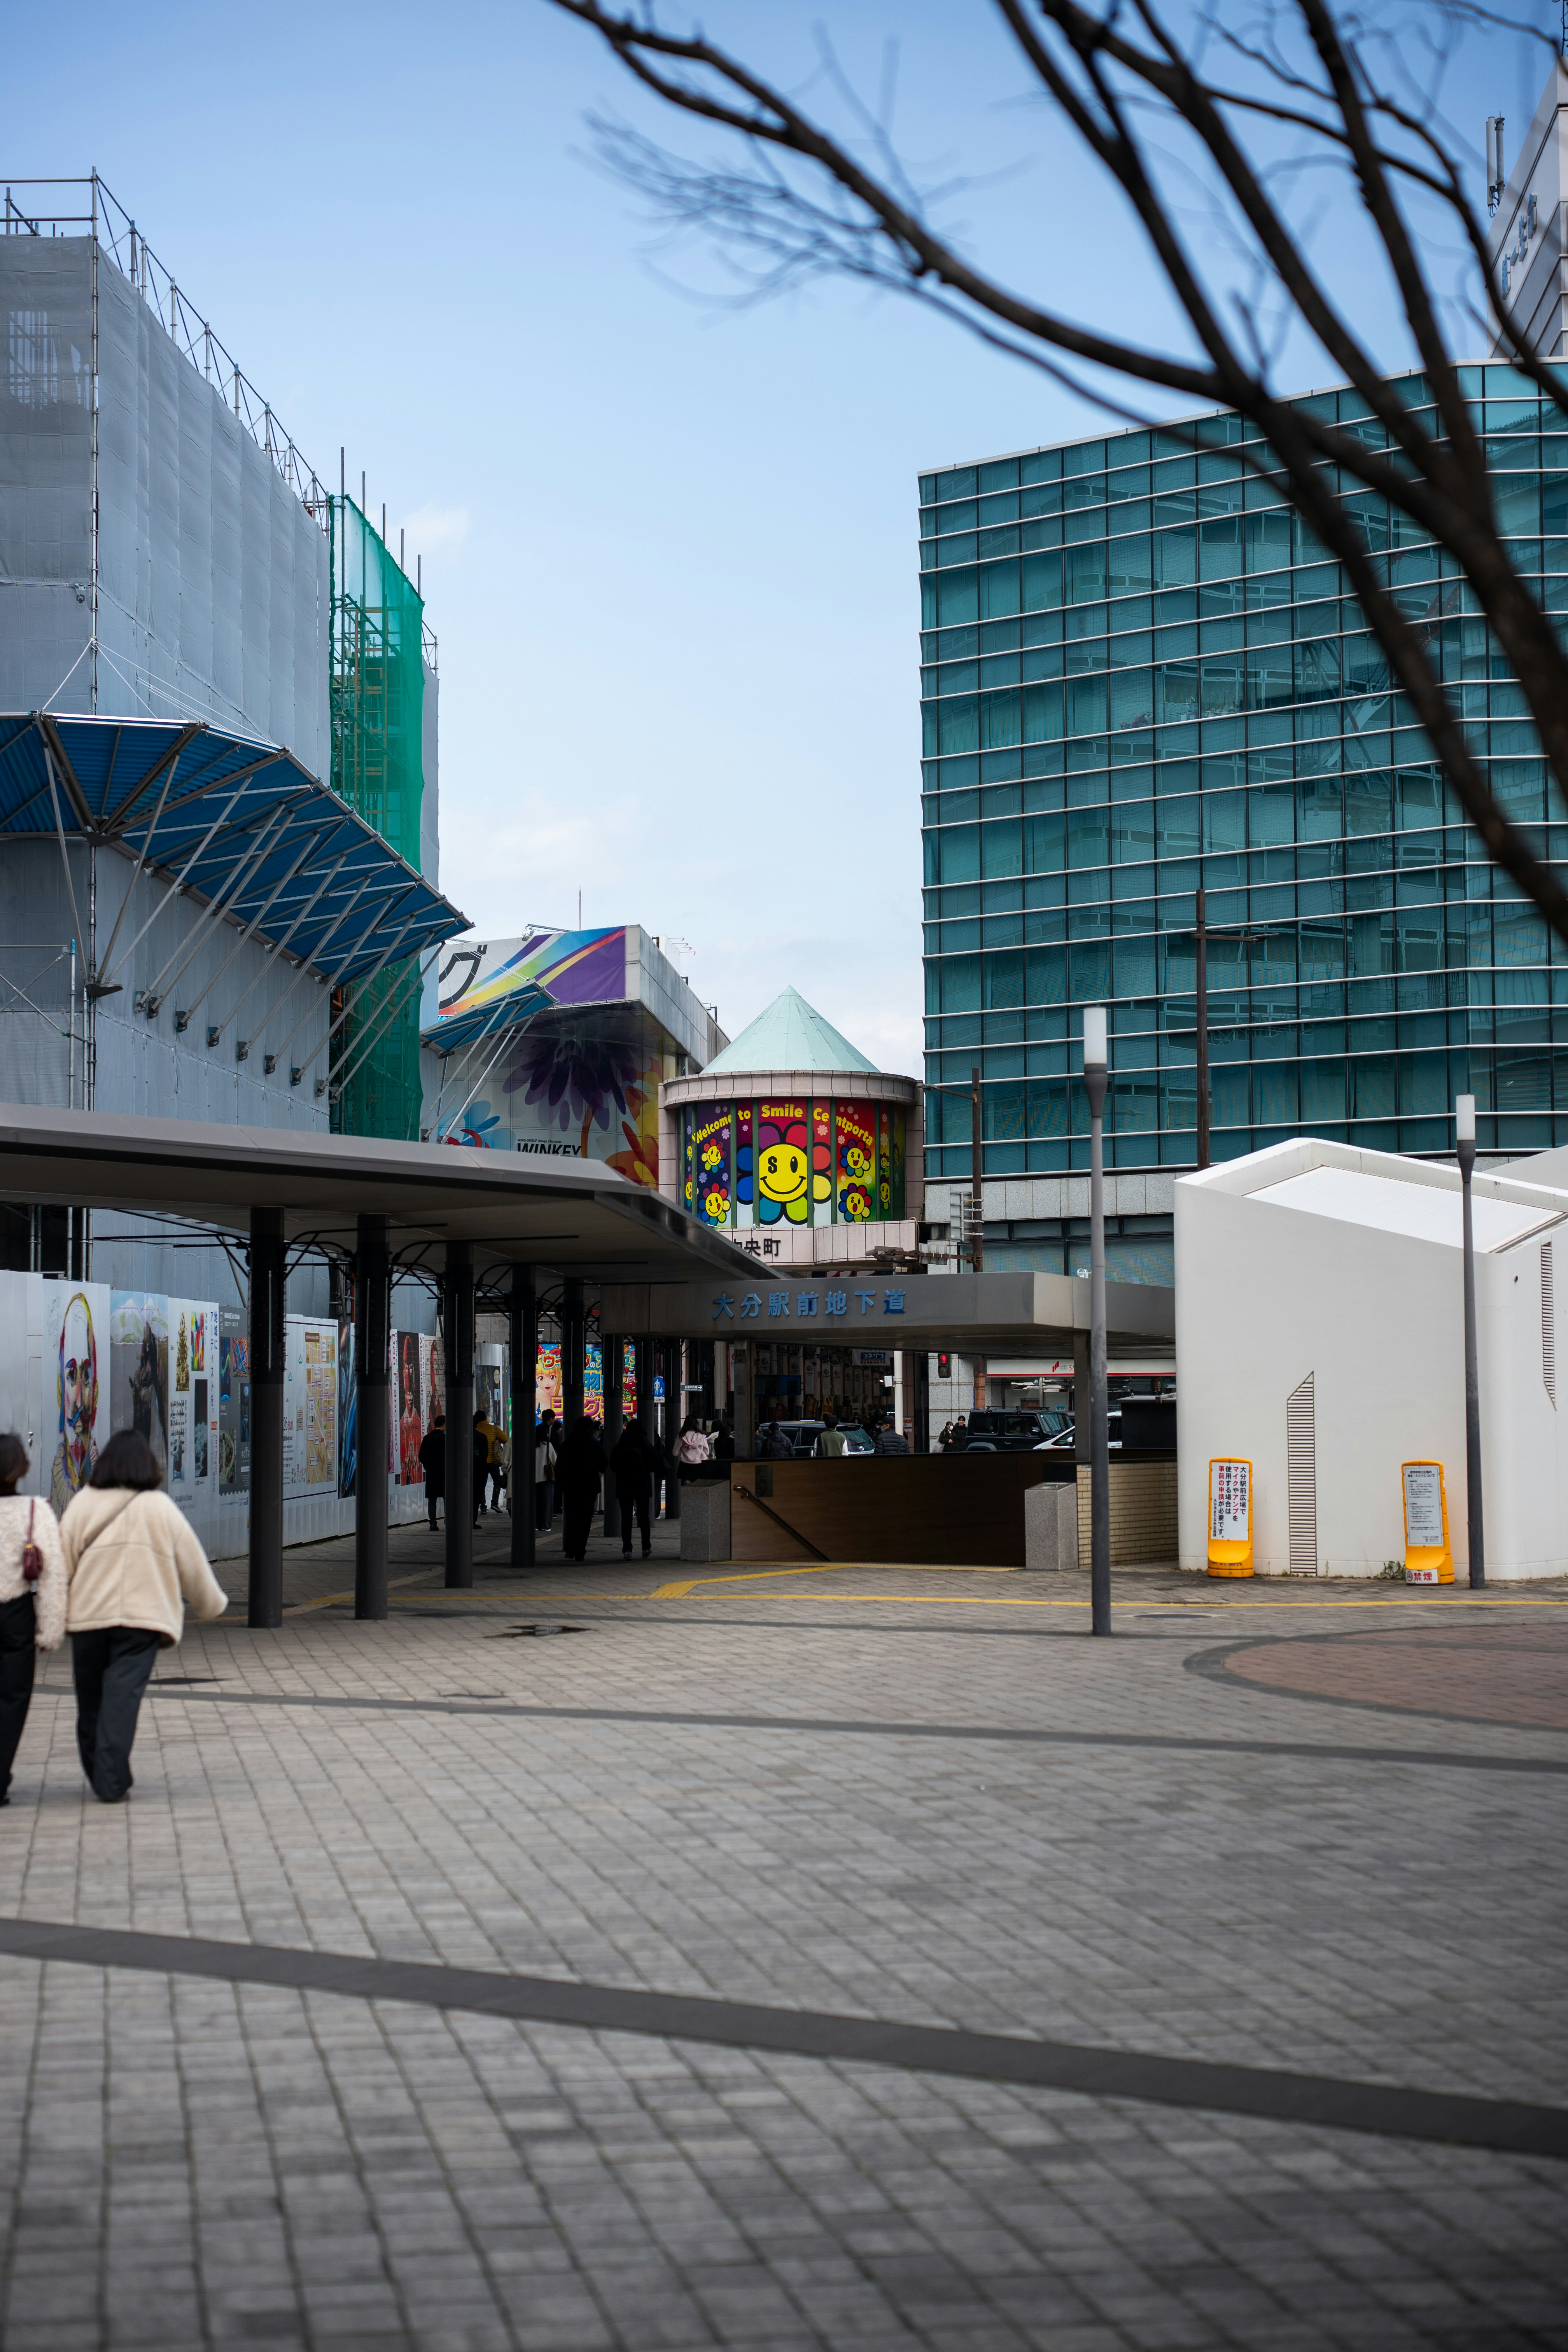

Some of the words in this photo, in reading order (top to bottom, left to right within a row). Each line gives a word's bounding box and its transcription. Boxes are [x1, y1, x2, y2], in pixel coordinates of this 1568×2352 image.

[691, 1114, 732, 1144] Welcome
[738, 1110, 751, 1120] to
[761, 1104, 803, 1118] Smile
[712, 1289, 906, 1320] 大分駅前地下道
[1414, 1572, 1433, 1581] 禁煙
